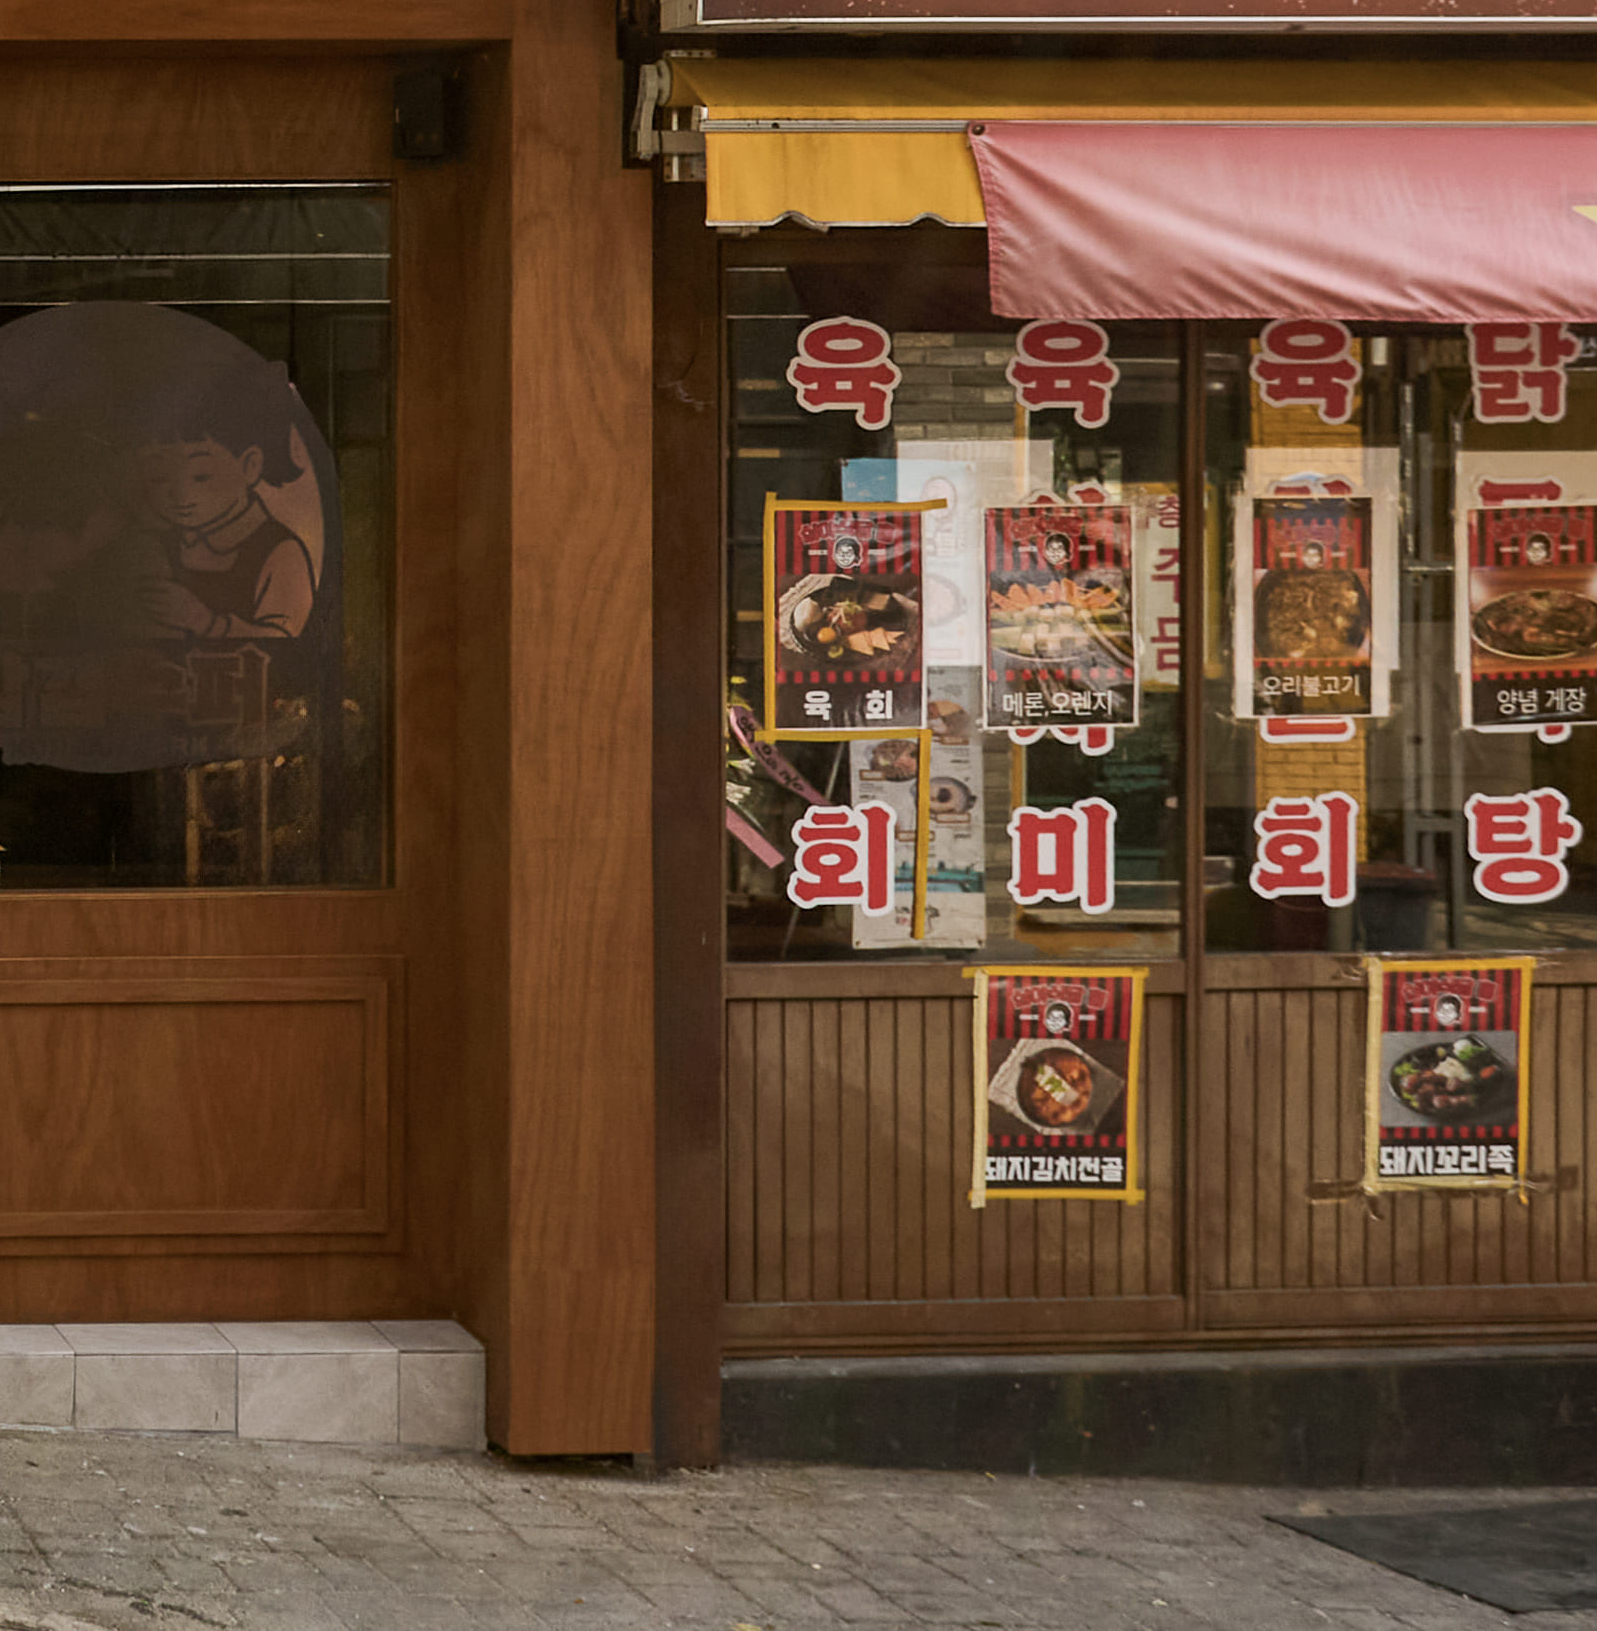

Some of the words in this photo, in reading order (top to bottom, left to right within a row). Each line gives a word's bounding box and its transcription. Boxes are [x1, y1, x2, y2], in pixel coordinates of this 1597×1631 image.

[1262, 673, 1361, 698] 오리불고기
[1497, 688, 1539, 715] 양념
[1544, 687, 1587, 713] 게장
[984, 1155, 1124, 1183] 돼지김치전골
